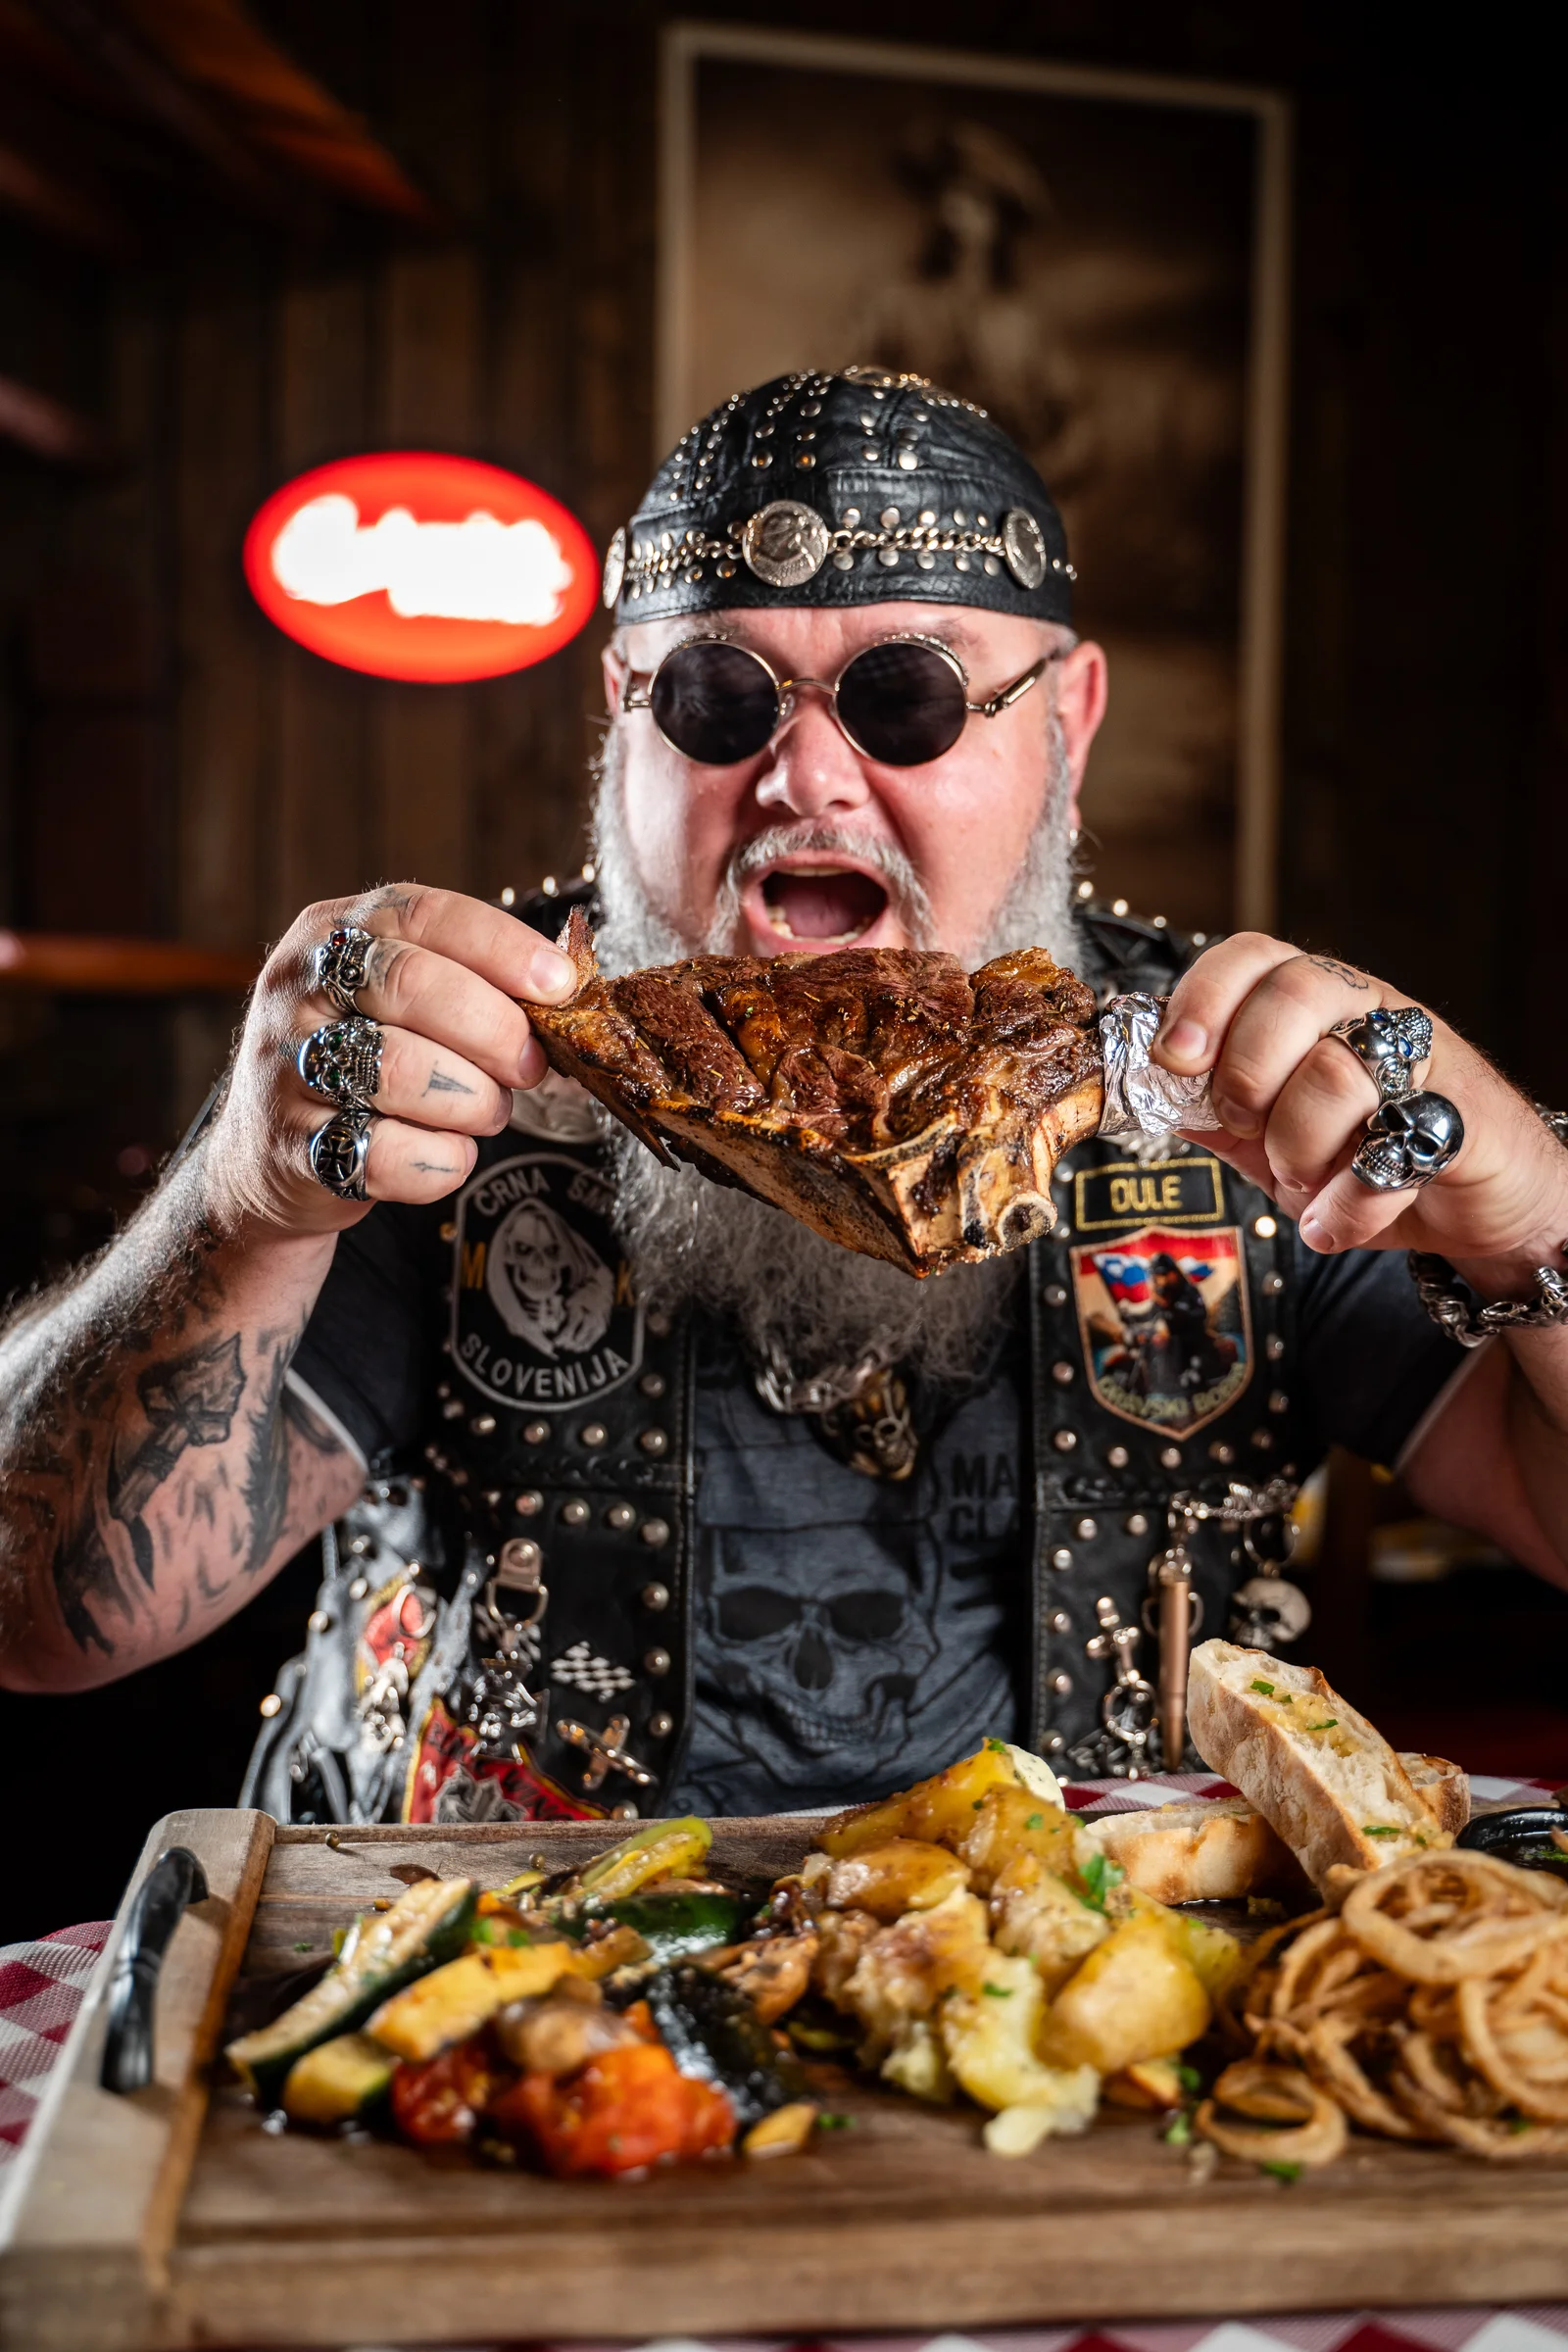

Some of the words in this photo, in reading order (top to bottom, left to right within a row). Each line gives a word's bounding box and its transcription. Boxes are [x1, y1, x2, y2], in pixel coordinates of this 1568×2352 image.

[473, 1166, 551, 1217] CRNA
[1109, 1175, 1183, 1214] DULE
[461, 1241, 487, 1290] M
[461, 1333, 629, 1398] SLOVENIJA
